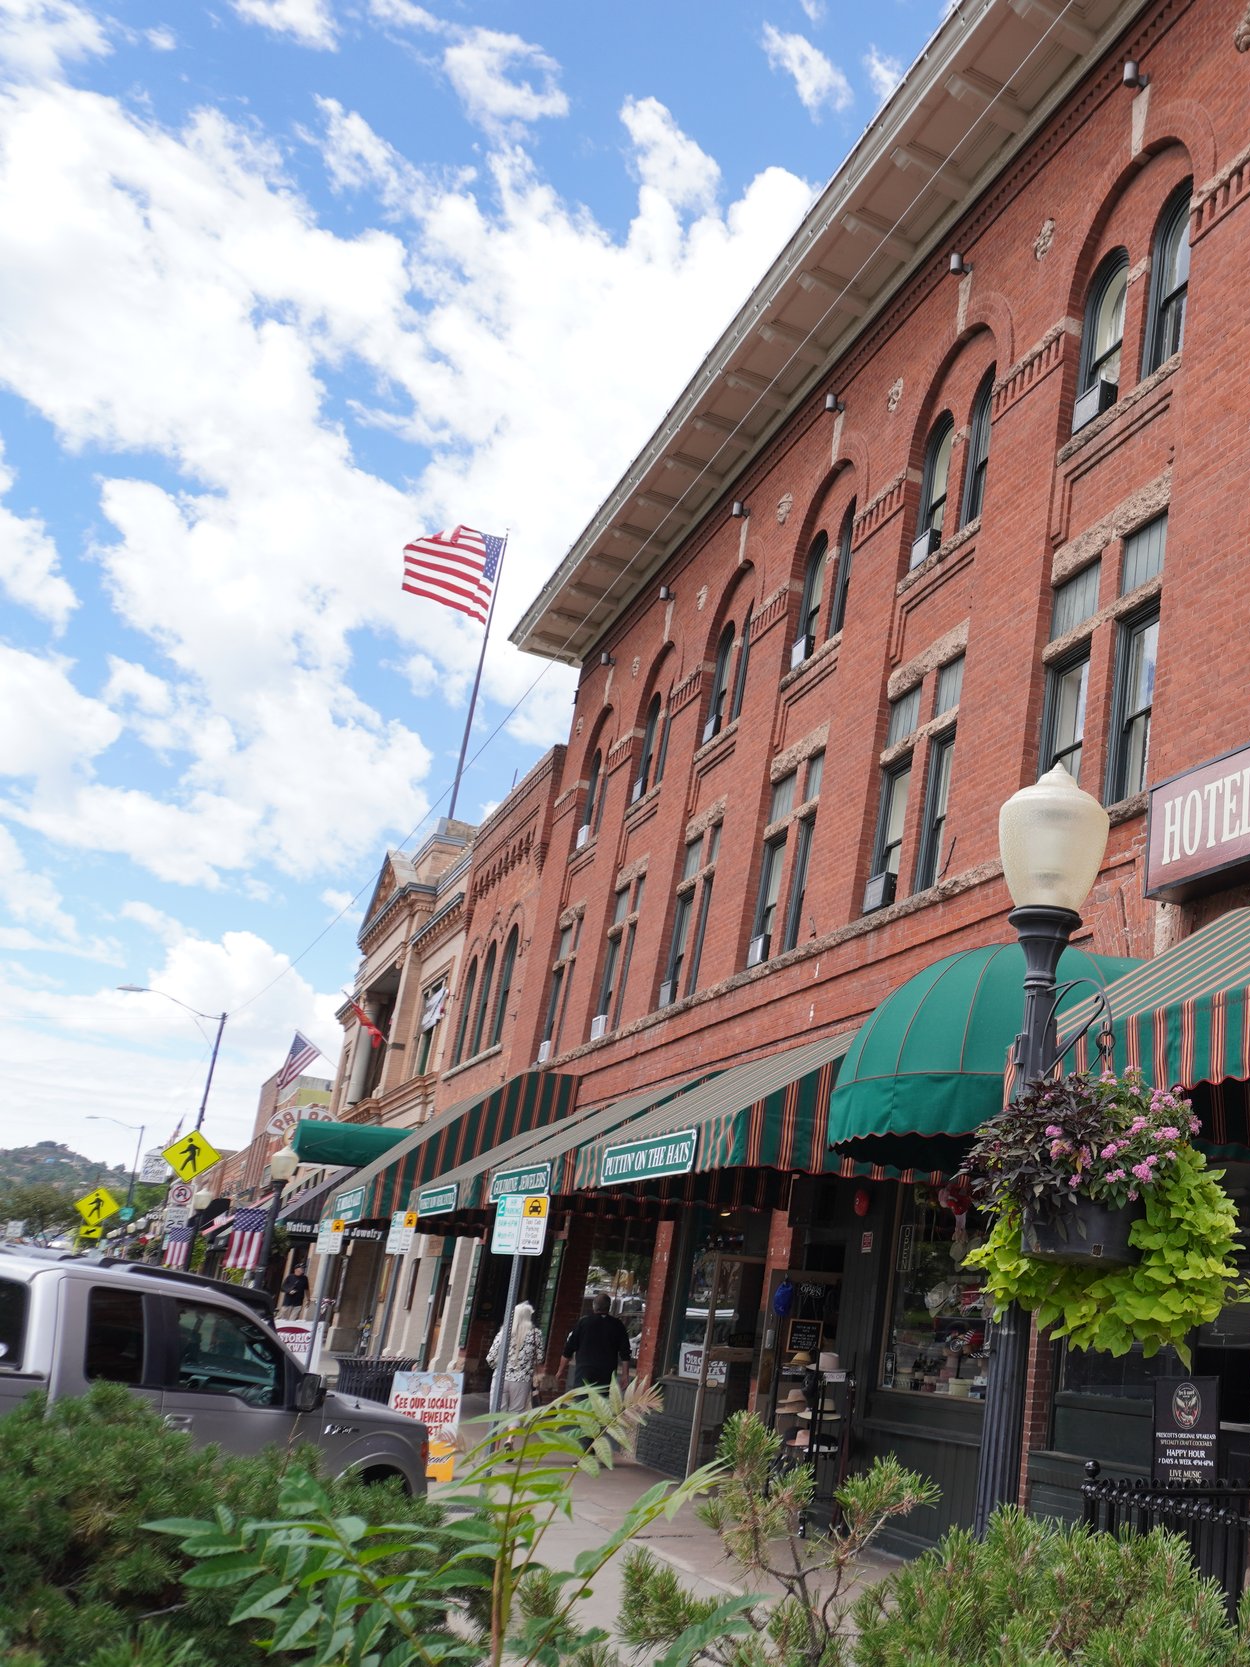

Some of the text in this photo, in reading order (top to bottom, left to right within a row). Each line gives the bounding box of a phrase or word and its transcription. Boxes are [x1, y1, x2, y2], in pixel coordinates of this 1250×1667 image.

[604, 1140, 692, 1177] PUTTIN' ON THE HATS
[499, 1199, 506, 1214] 2
[165, 1219, 184, 1229] 25
[285, 1221, 312, 1234] Native
[350, 1226, 383, 1241] Jewelry
[394, 1394, 458, 1409] SEE OUR LOCALLY
[420, 1410, 456, 1423] JEWELRY
[1166, 1449, 1206, 1458] HAPPY HOUR
[1178, 1458, 1192, 1466] WEEK
[1169, 1469, 1202, 1479] LIVE MUSIC
